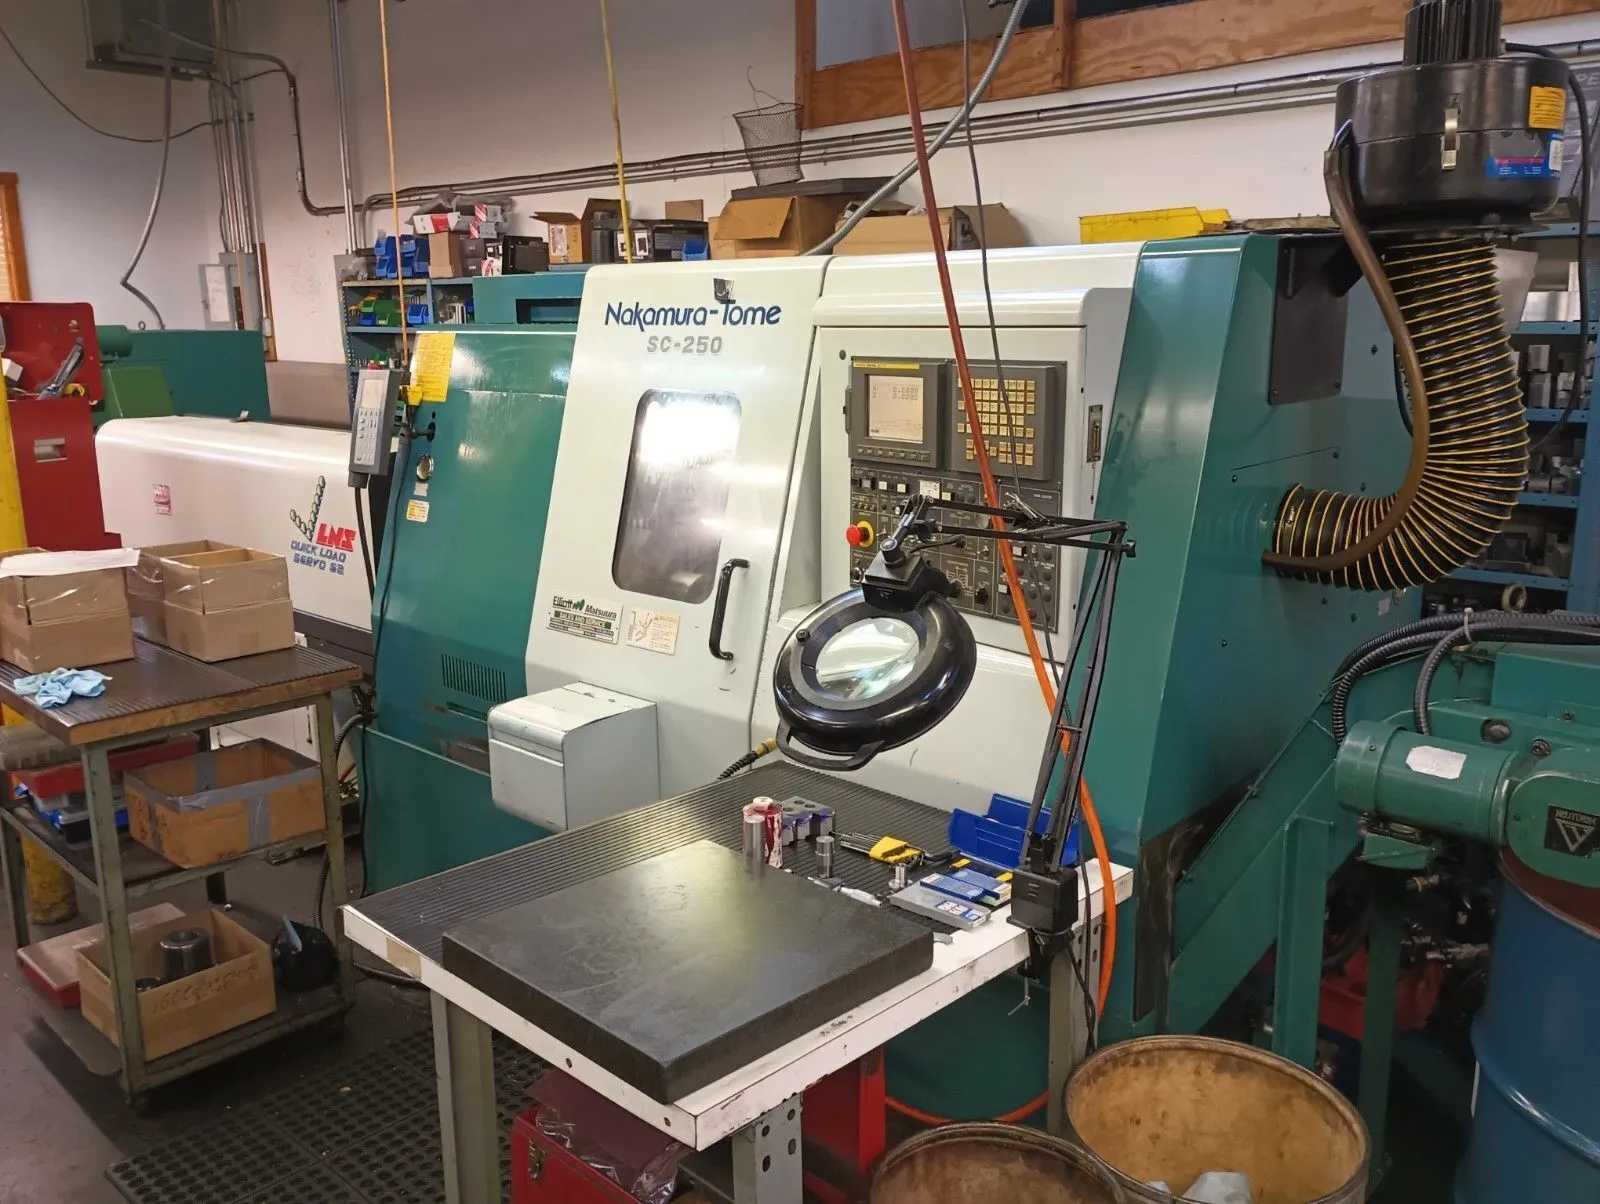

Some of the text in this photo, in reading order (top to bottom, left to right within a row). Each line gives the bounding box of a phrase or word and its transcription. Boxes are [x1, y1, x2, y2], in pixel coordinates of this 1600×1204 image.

[604, 301, 782, 332] Nakamura-Tome
[646, 335, 723, 354] SC-250
[291, 540, 346, 562] QUICK LOAD
[294, 553, 326, 570] SERVO
